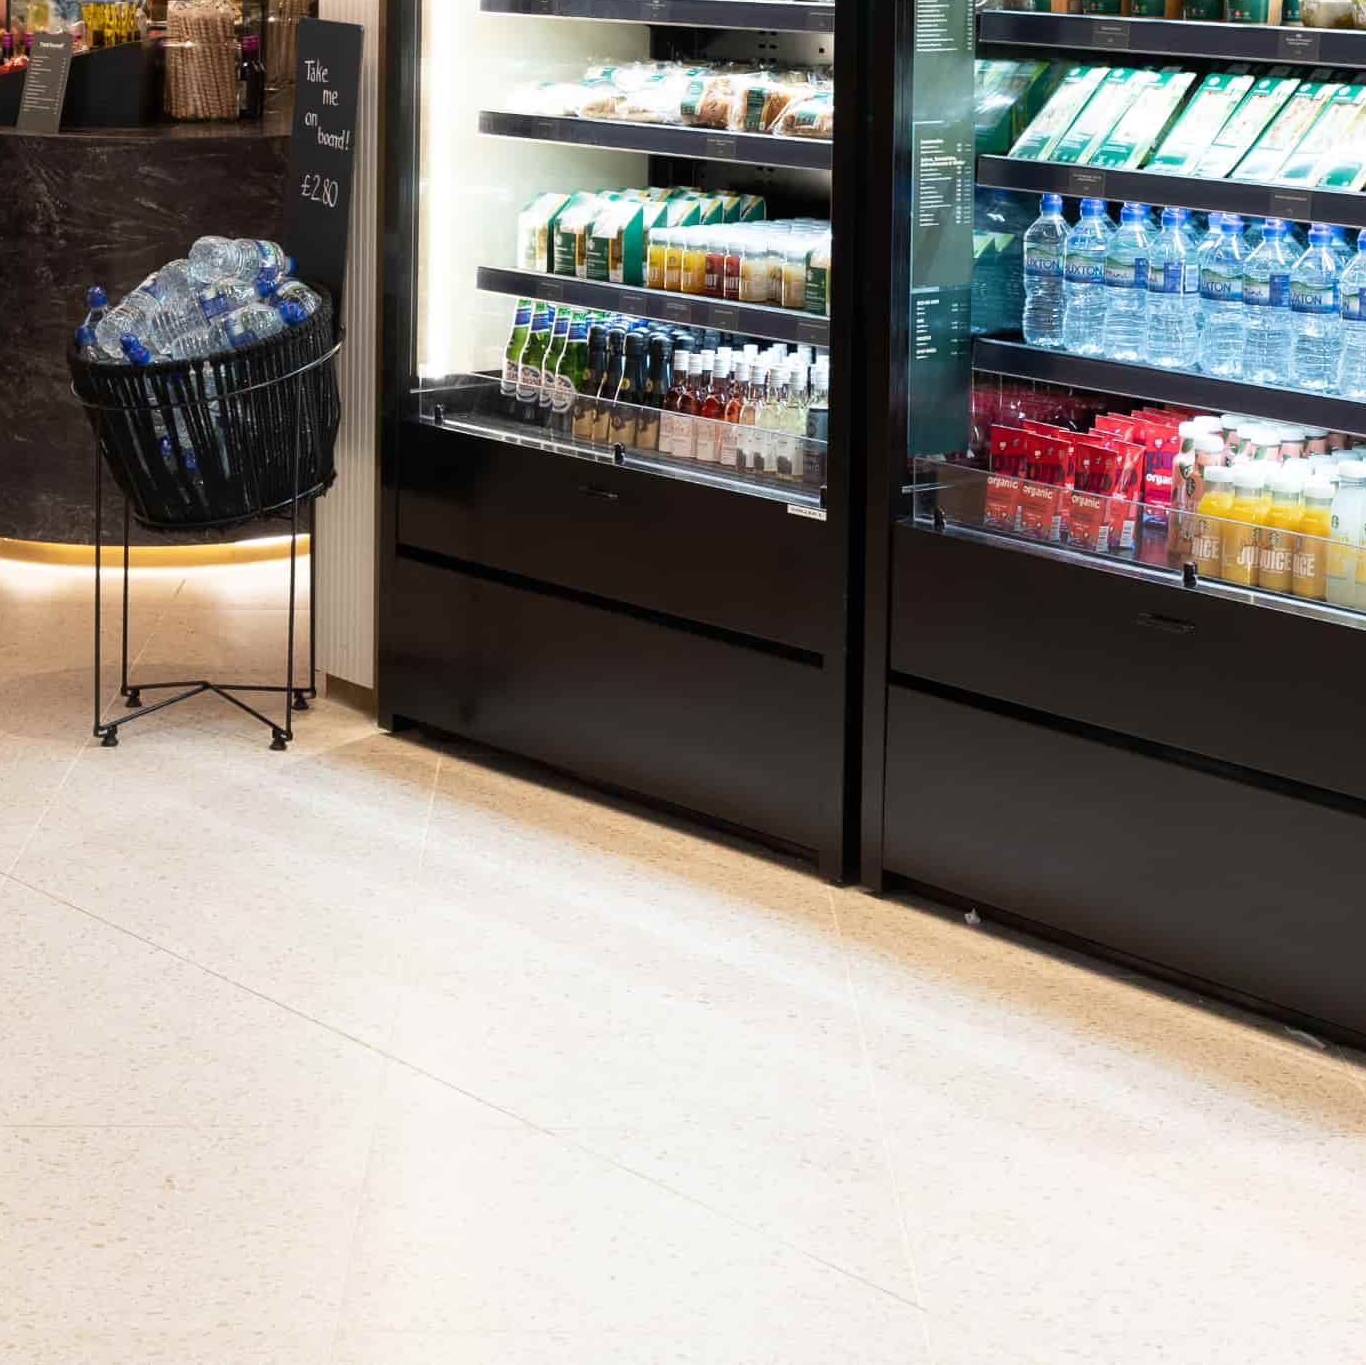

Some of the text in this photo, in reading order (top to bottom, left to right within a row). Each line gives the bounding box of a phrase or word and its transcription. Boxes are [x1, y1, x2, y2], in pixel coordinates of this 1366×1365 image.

[304, 58, 329, 83] Take
[322, 89, 340, 107] me
[305, 112, 318, 127] on
[317, 126, 350, 151] board!
[987, 476, 1019, 490] organic
[1023, 484, 1053, 500] organic
[1071, 493, 1100, 509] organic
